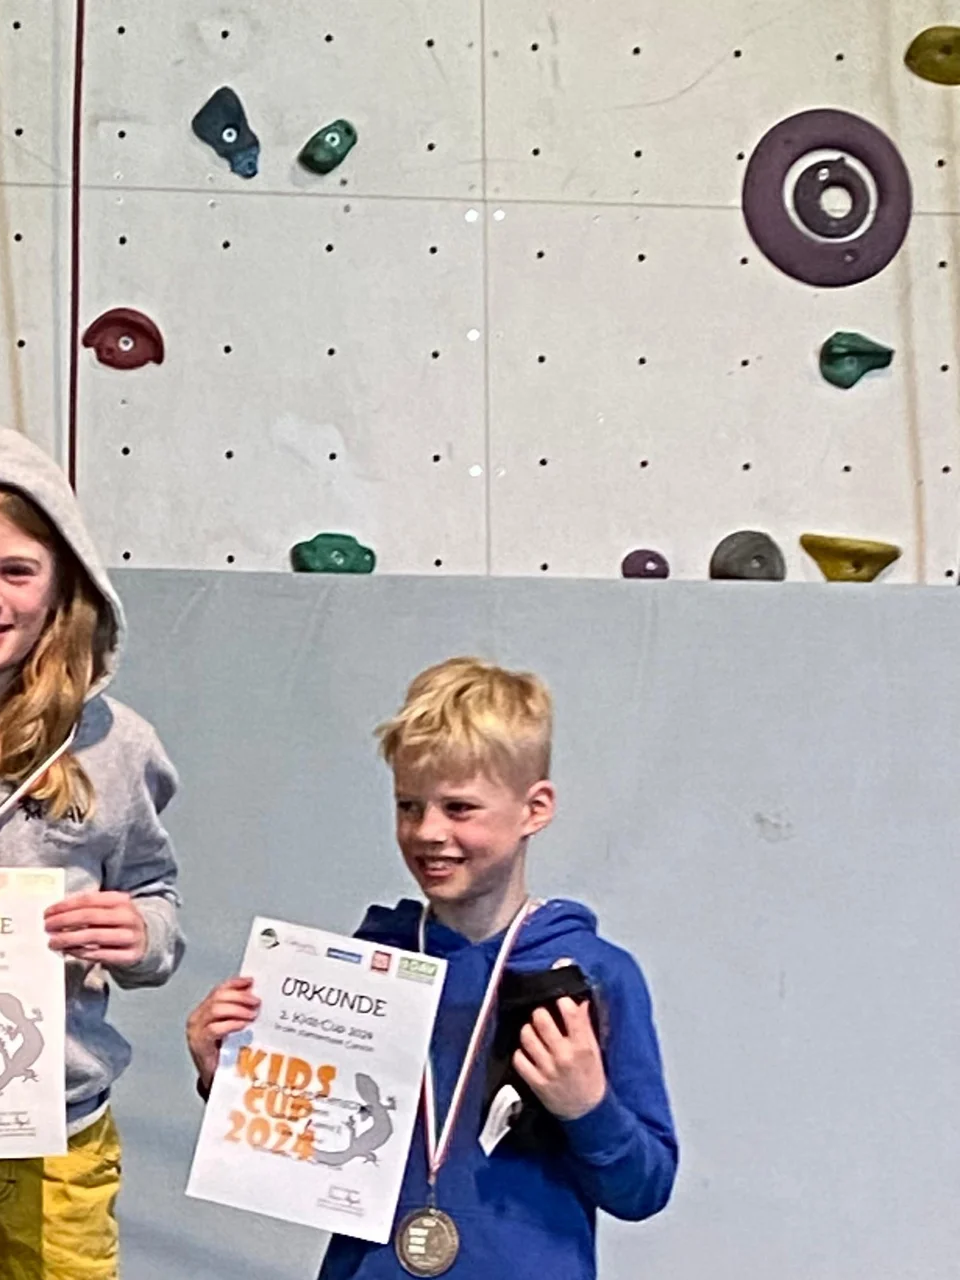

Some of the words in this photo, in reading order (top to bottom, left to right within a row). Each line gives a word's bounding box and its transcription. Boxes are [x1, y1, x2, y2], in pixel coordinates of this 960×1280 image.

[281, 977, 387, 1017] URKUNDE
[236, 1046, 337, 1097] KIDS
[243, 1087, 314, 1120] CUP
[224, 1110, 317, 1161] 2024
